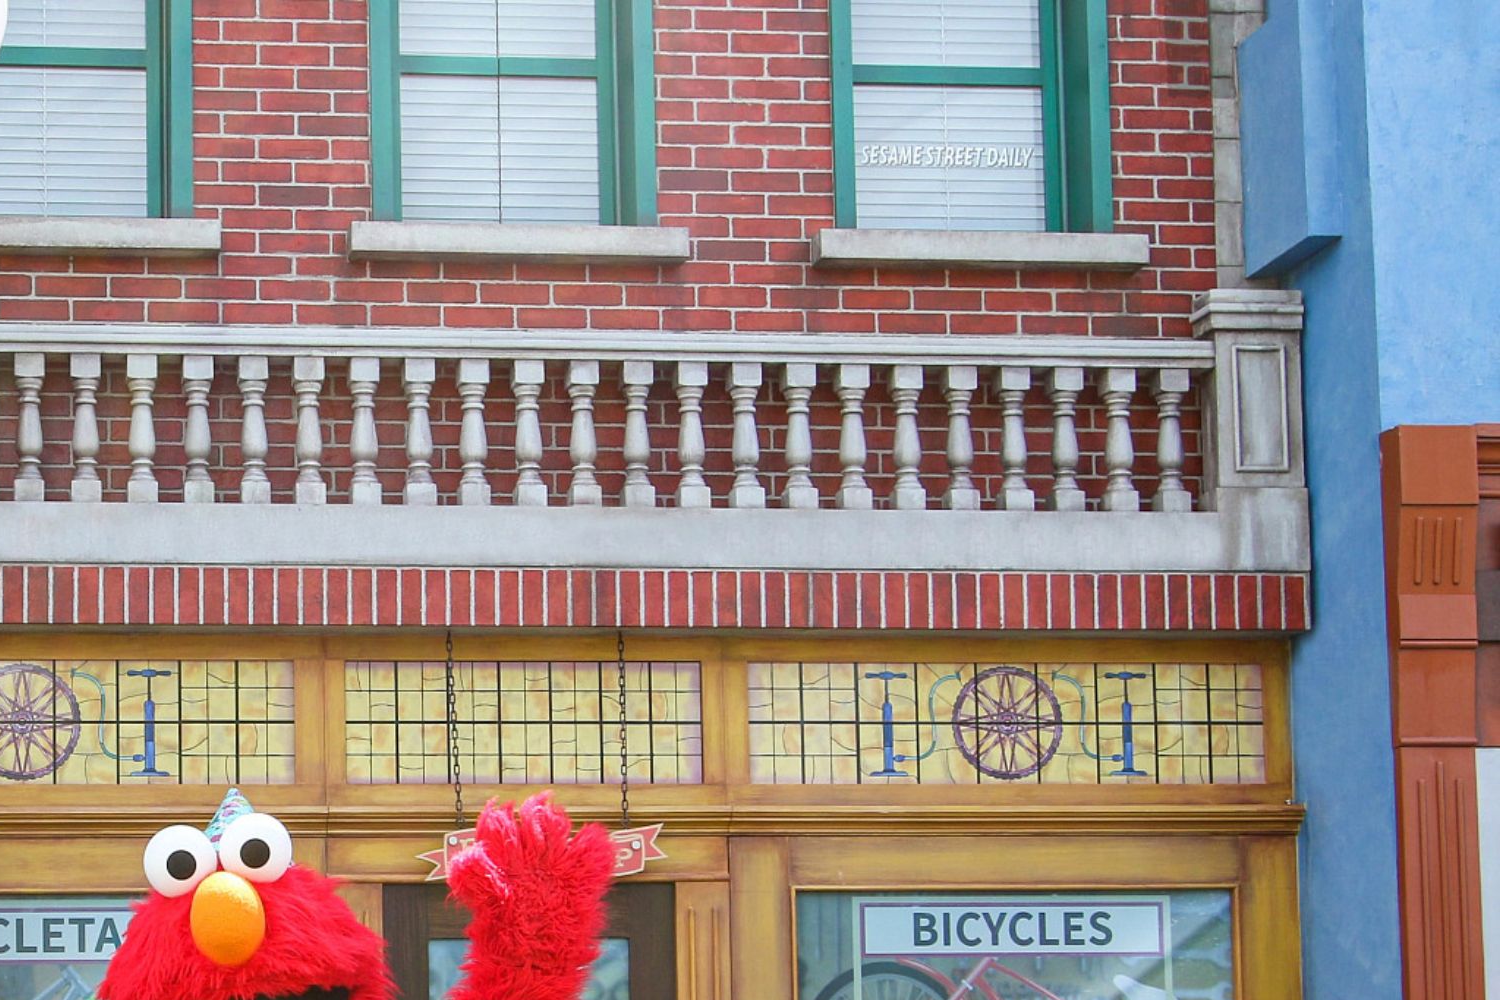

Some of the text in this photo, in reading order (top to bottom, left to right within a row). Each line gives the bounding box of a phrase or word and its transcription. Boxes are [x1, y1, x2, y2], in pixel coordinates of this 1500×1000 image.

[861, 144, 1036, 168] SESAME STREET DAILY
[912, 911, 1114, 947] BICYCLES
